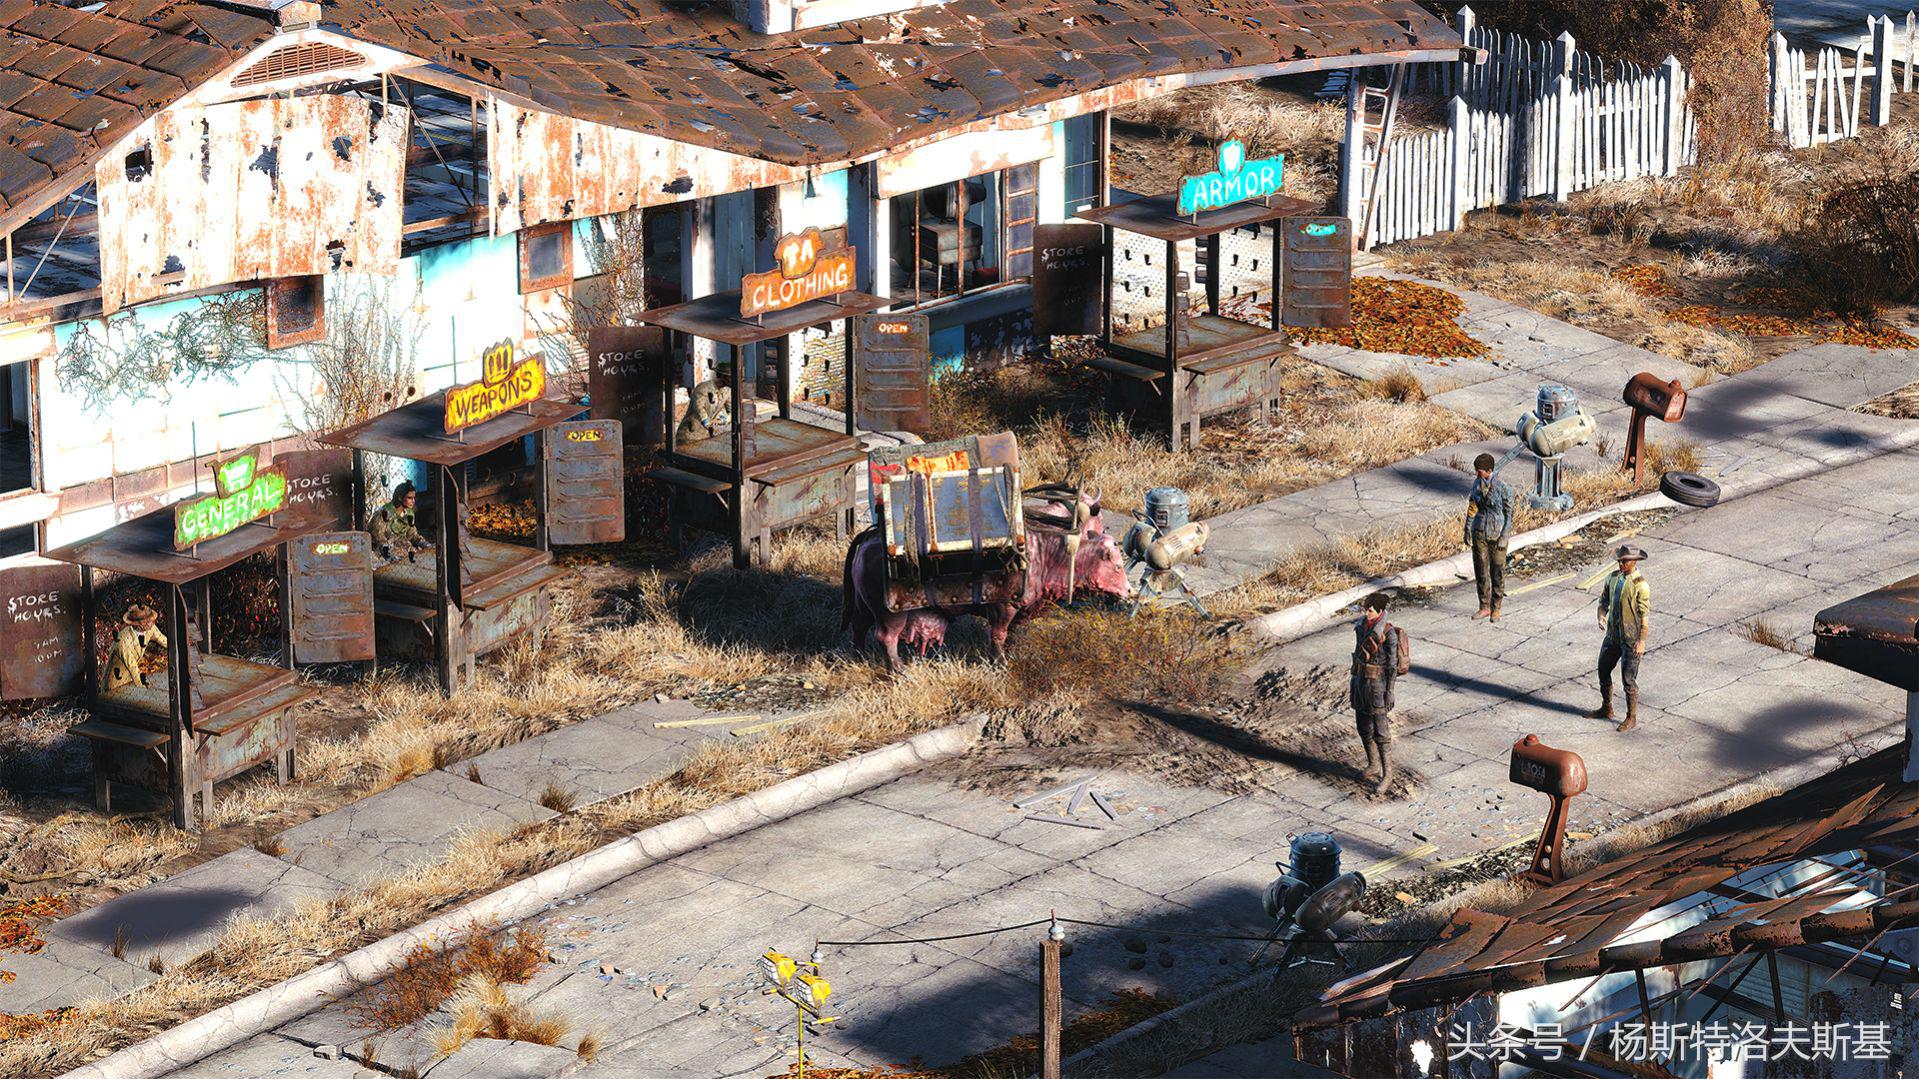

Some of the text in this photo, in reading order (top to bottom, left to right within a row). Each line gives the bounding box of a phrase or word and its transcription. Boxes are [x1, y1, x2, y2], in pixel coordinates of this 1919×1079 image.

[1193, 166, 1276, 210] ARMOR
[1041, 246, 1085, 262] STORE
[752, 262, 848, 308] CLOTHING
[878, 323, 908, 334] OPEN
[597, 349, 647, 370] STORE
[456, 370, 533, 418] WEAPONS
[571, 430, 601, 441] OPEN
[182, 480, 281, 534] GENERAL
[316, 543, 348, 554] OPEN
[7, 590, 60, 615] STORE
